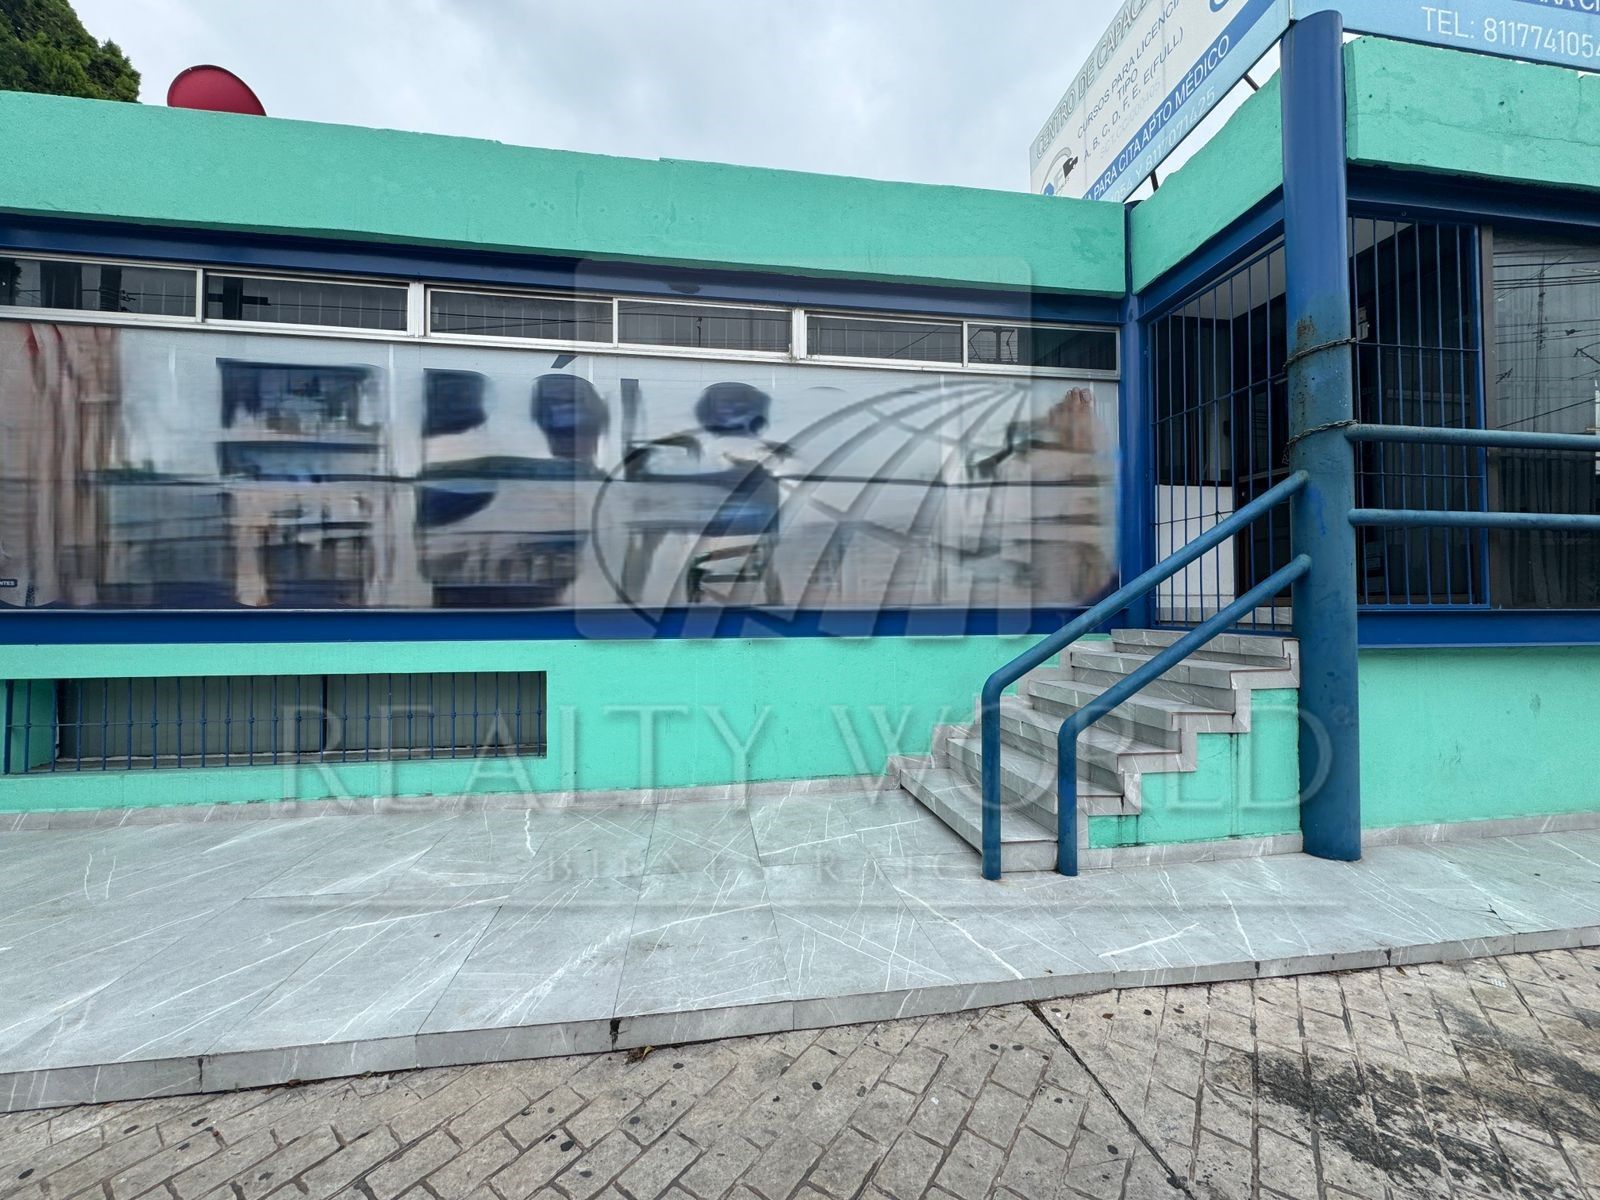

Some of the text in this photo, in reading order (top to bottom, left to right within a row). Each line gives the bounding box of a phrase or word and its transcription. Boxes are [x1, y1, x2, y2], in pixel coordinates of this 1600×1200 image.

[1143, 26, 1184, 86] E(FULL)
[1421, 6, 1475, 39] TEL:
[1036, 88, 1076, 159] CENTRO
[1078, 56, 1095, 101] DE
[1077, 89, 1110, 139] CURSOS
[1111, 56, 1135, 93] PARA
[1093, 165, 1118, 200] PARA
[1118, 137, 1140, 172] CITA
[1141, 101, 1172, 151] APTO
[1175, 34, 1230, 109] MÉDICO
[1117, 68, 1138, 101] TIPO
